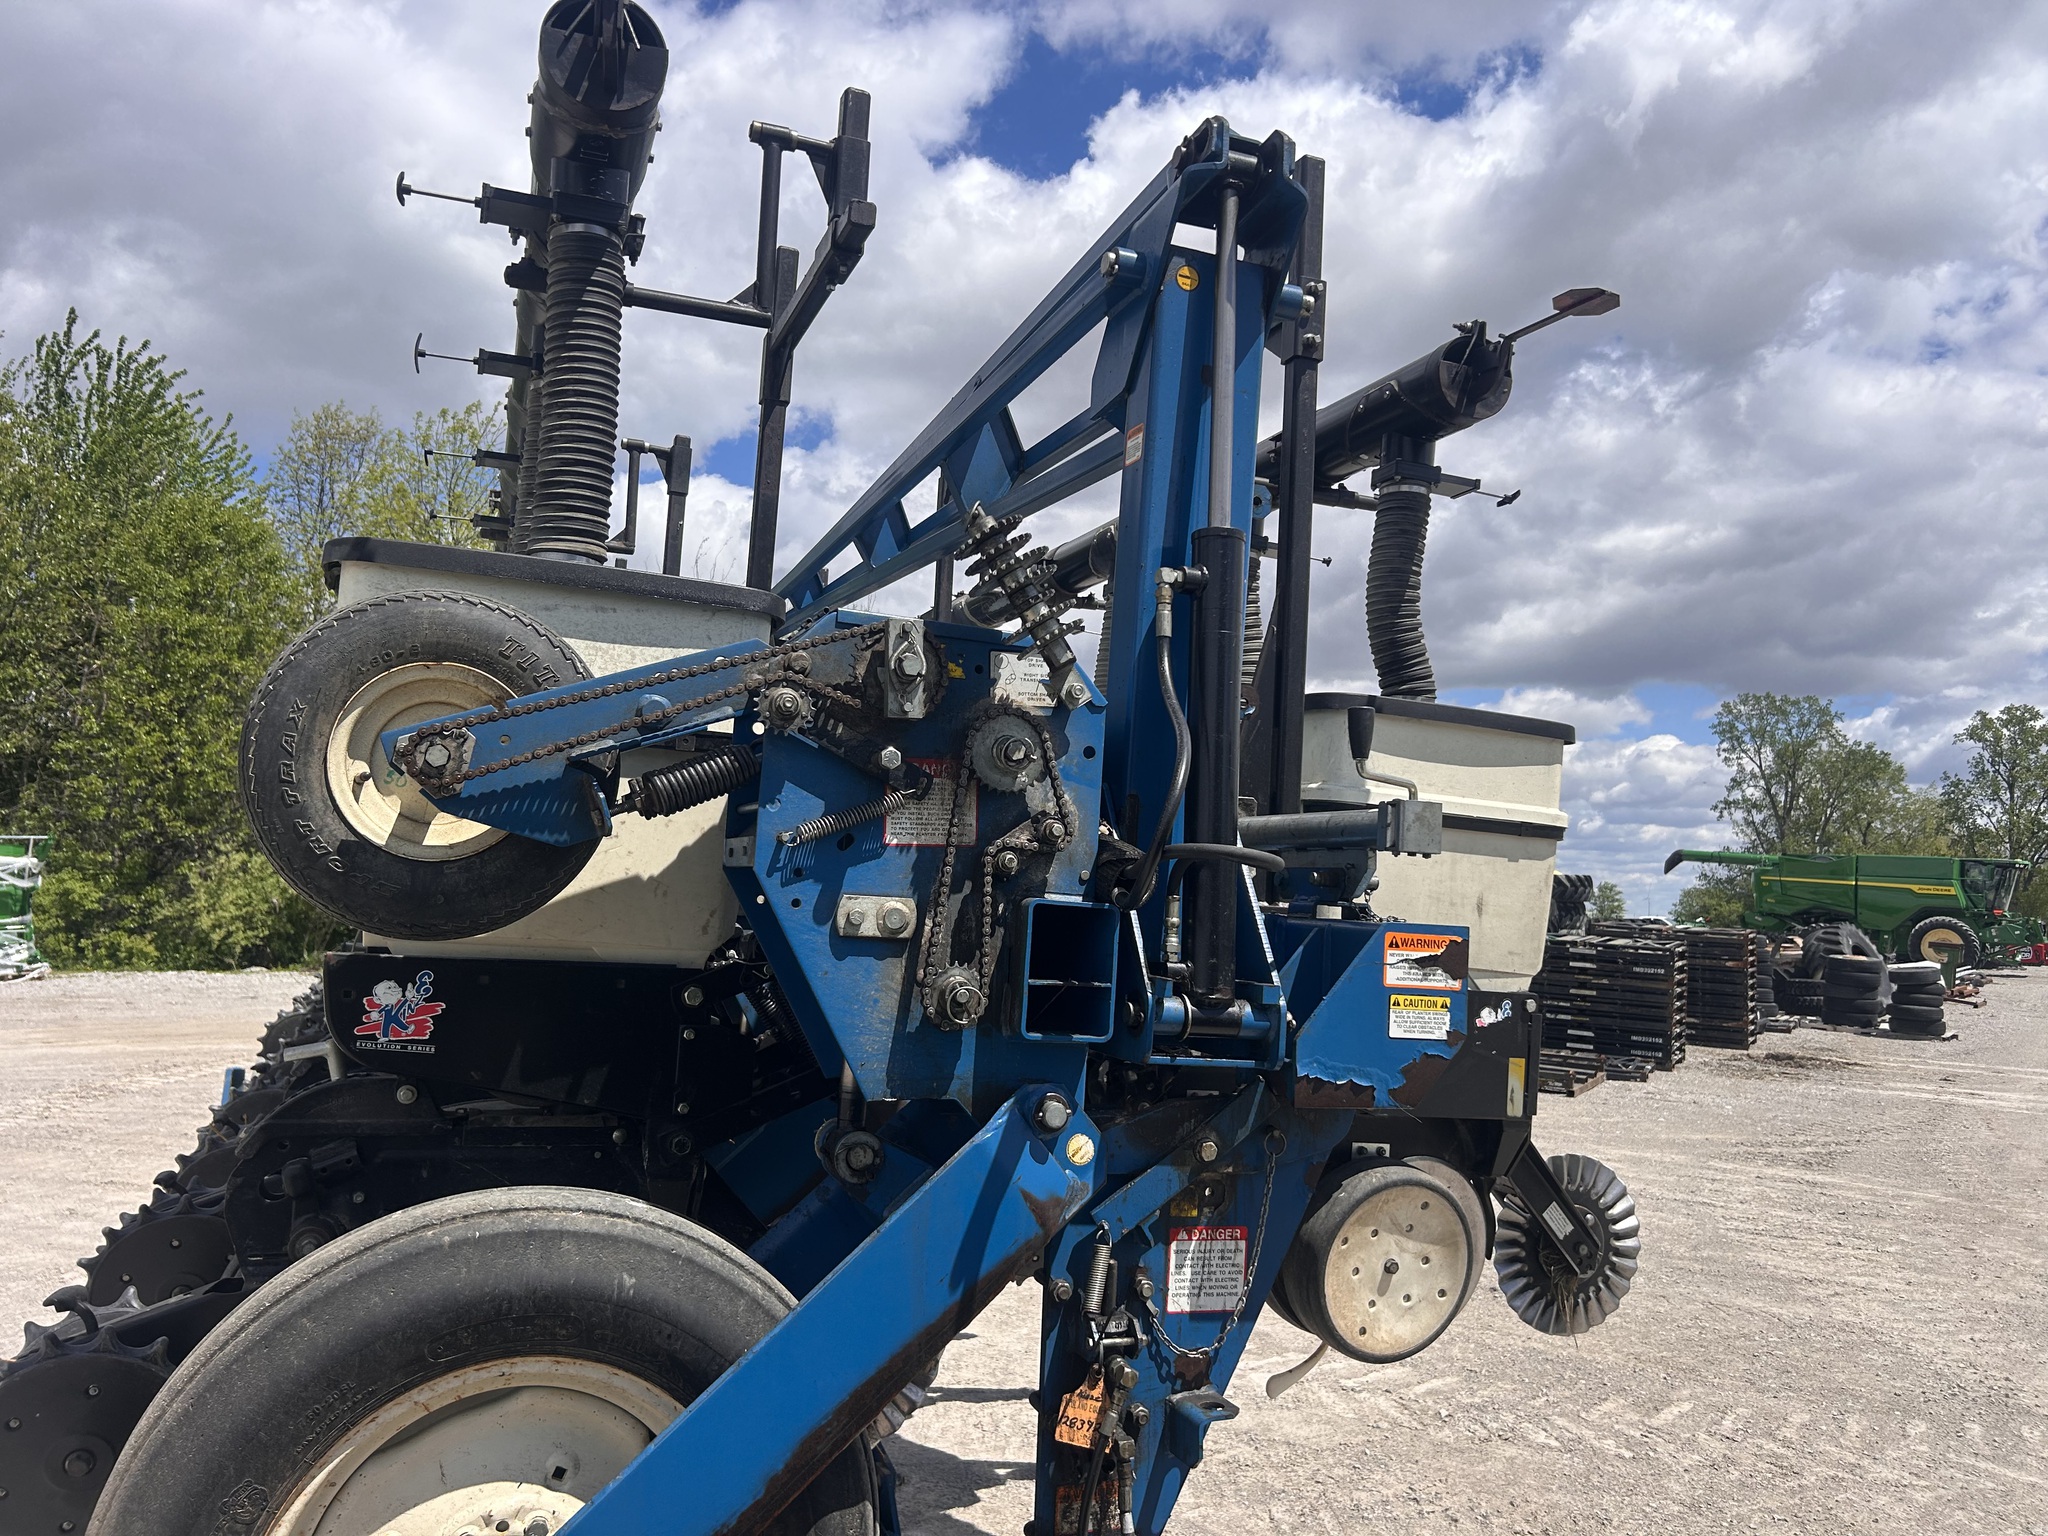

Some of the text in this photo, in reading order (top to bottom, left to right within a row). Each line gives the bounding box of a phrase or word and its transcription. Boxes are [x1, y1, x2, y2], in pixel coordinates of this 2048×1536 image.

[279, 697, 308, 808] TRAX
[1403, 998, 1438, 1009] CAUTION
[356, 1041, 401, 1050] EVOLUTION
[1191, 1229, 1241, 1240] DANGER
